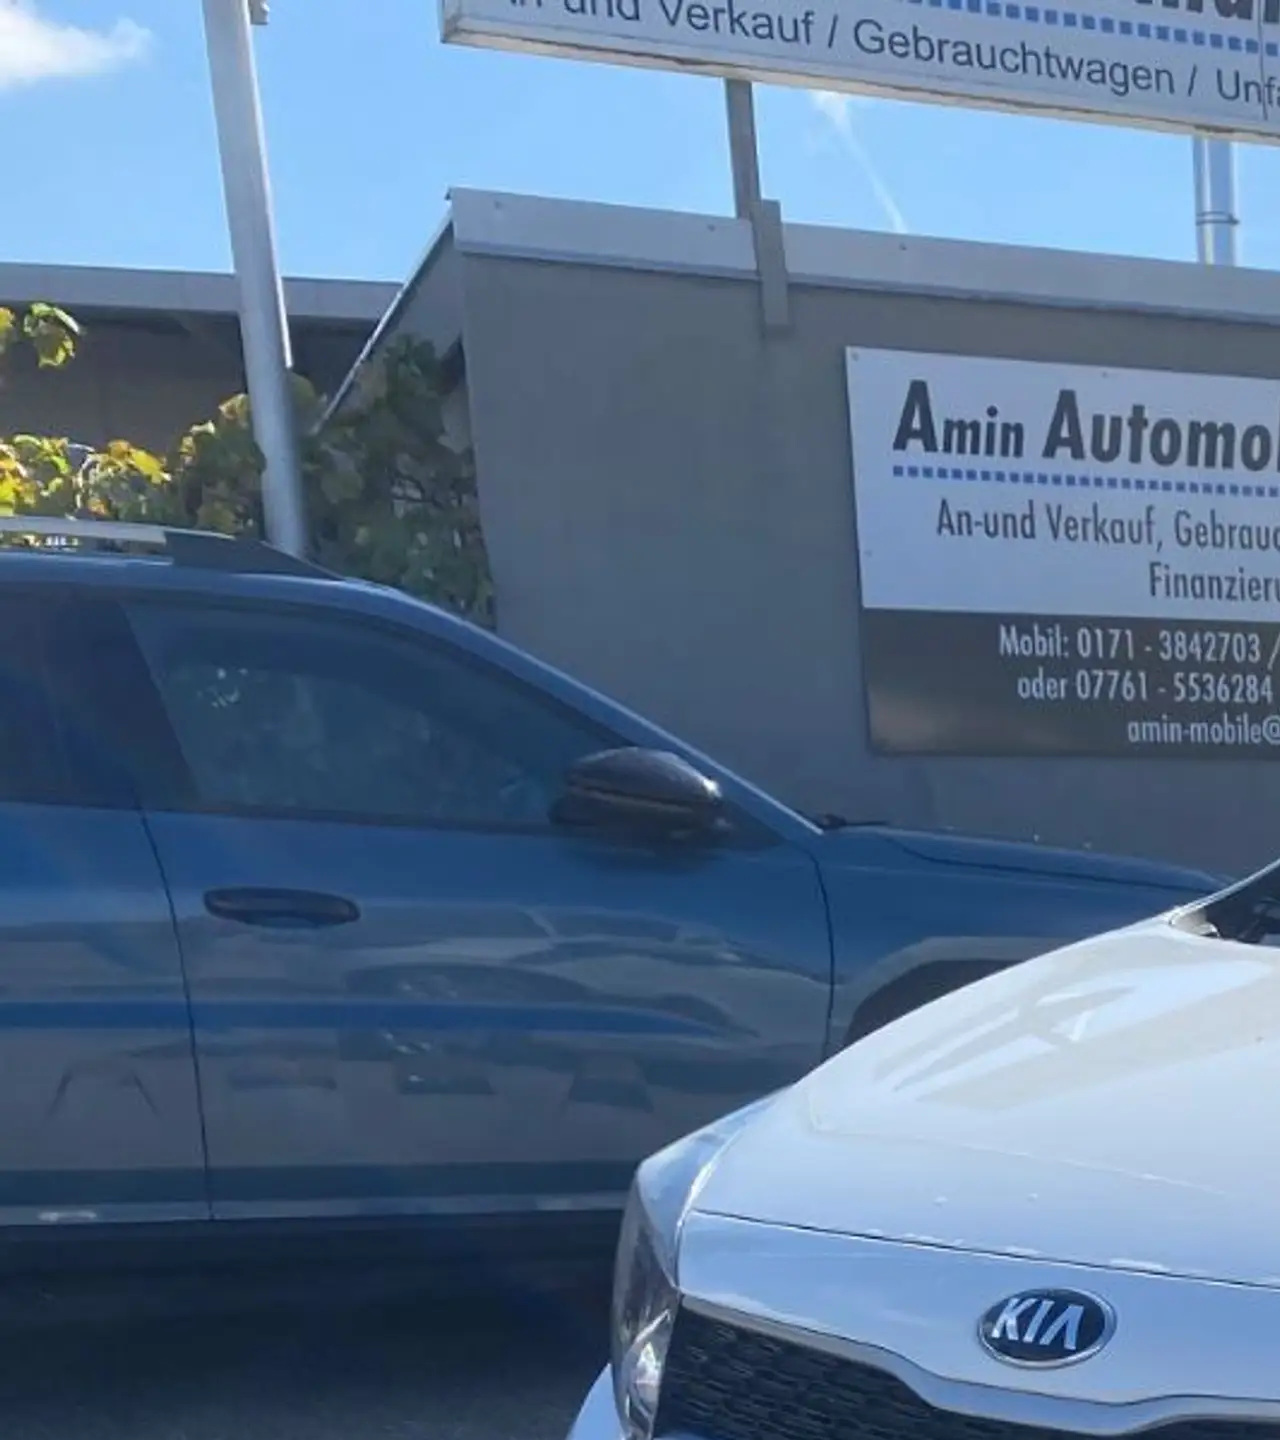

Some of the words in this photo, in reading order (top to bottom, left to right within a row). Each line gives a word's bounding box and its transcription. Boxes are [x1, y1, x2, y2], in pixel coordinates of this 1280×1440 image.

[660, 0, 815, 46] Verkauf
[853, 18, 1176, 97] Gebrauchtwagen
[893, 379, 1024, 458] Amin
[937, 498, 1036, 540] An-und
[1045, 502, 1162, 552] Verkauf,
[1000, 623, 1069, 658] Mobil:
[1077, 627, 1134, 660] 0171
[1158, 630, 1260, 663] 3842703
[1018, 666, 1068, 699] oder
[1076, 670, 1147, 700] 07761
[1173, 671, 1273, 704] 5536284
[991, 1298, 1085, 1350] KIA
